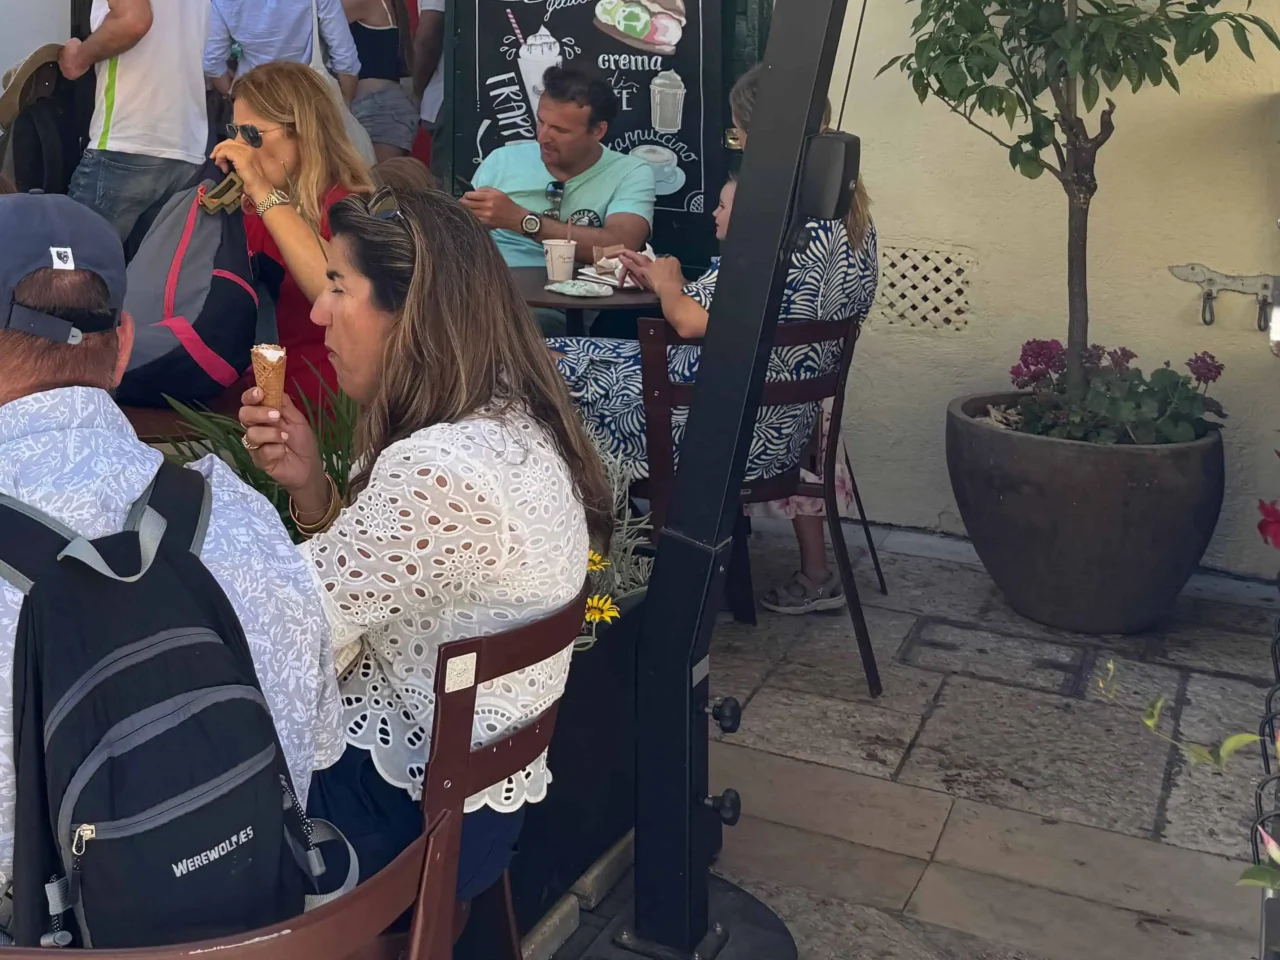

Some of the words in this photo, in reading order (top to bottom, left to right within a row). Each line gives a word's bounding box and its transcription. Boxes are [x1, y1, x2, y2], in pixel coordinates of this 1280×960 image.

[597, 53, 663, 71] crema
[607, 70, 640, 88] di
[485, 71, 535, 144] FRAPP
